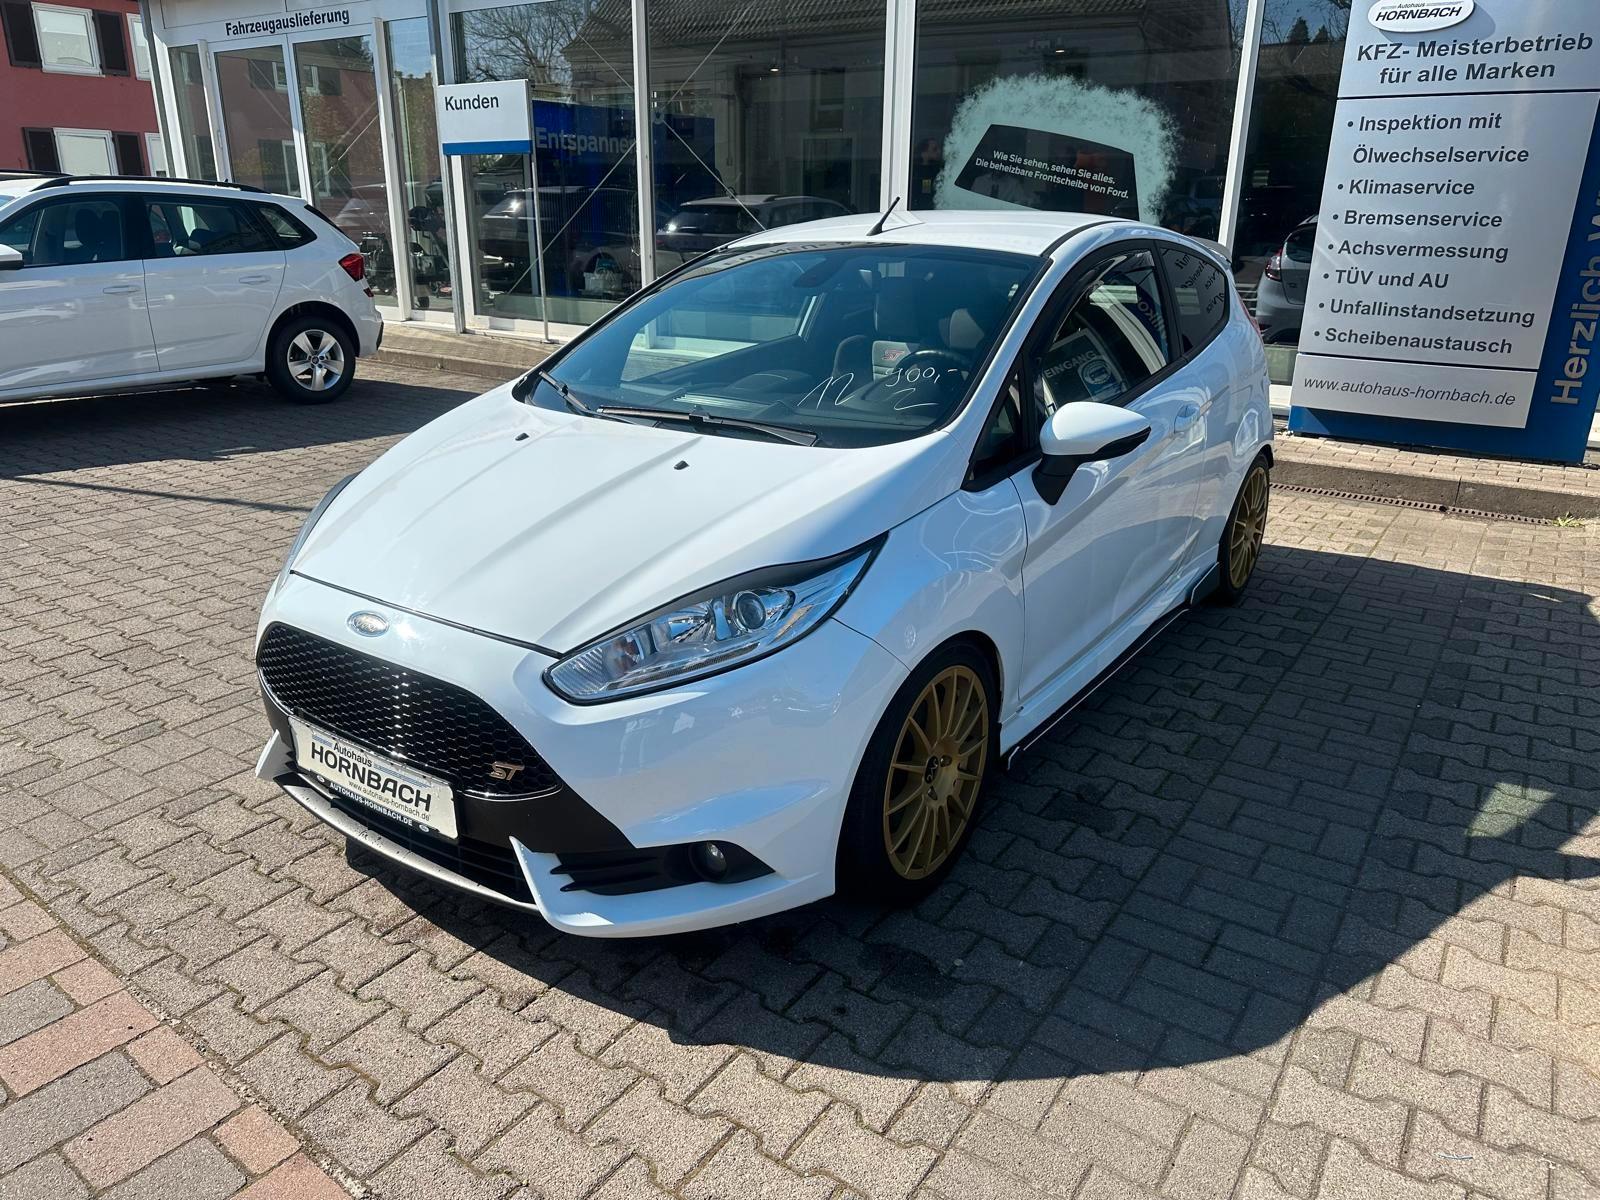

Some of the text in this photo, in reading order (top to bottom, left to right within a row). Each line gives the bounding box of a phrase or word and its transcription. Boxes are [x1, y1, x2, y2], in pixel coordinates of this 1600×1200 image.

[1375, 6, 1463, 22] HORNBACH
[1398, 1, 1425, 9] Autohaus
[225, 9, 350, 36] Fahrzeugauslieferung
[1357, 32, 1593, 61] KFZ- Meisterbetrieb
[1379, 61, 1555, 84] für alle Marken
[444, 94, 499, 111] Kunden
[1359, 112, 1502, 135] Inspektion mit
[993, 150, 1115, 184] Wie Sie sehen, sehen Sie alles.
[1353, 144, 1529, 164] Ölwechselservice
[975, 157, 1129, 199] Die beheizbare Frontscheibe von Ford.
[1349, 178, 1475, 195] Klimaservice
[1344, 209, 1503, 228] Bremsenservice
[1337, 239, 1509, 263] Achsvermessung
[1335, 266, 1449, 289] TÜV und AU
[1330, 298, 1535, 328] Unfallinstandsetzung
[1325, 327, 1513, 354] Scheibenaustausch
[1044, 350, 1096, 378] EINGANG
[796, 372, 856, 410] 12
[1304, 377, 1516, 406] www.autohaus-hornbach.de
[333, 742, 373, 768] Autohaus
[311, 741, 432, 812] HORNBACH
[489, 761, 525, 781] ST
[329, 782, 413, 827] AUTOHAUS-HORNBACH.DE
